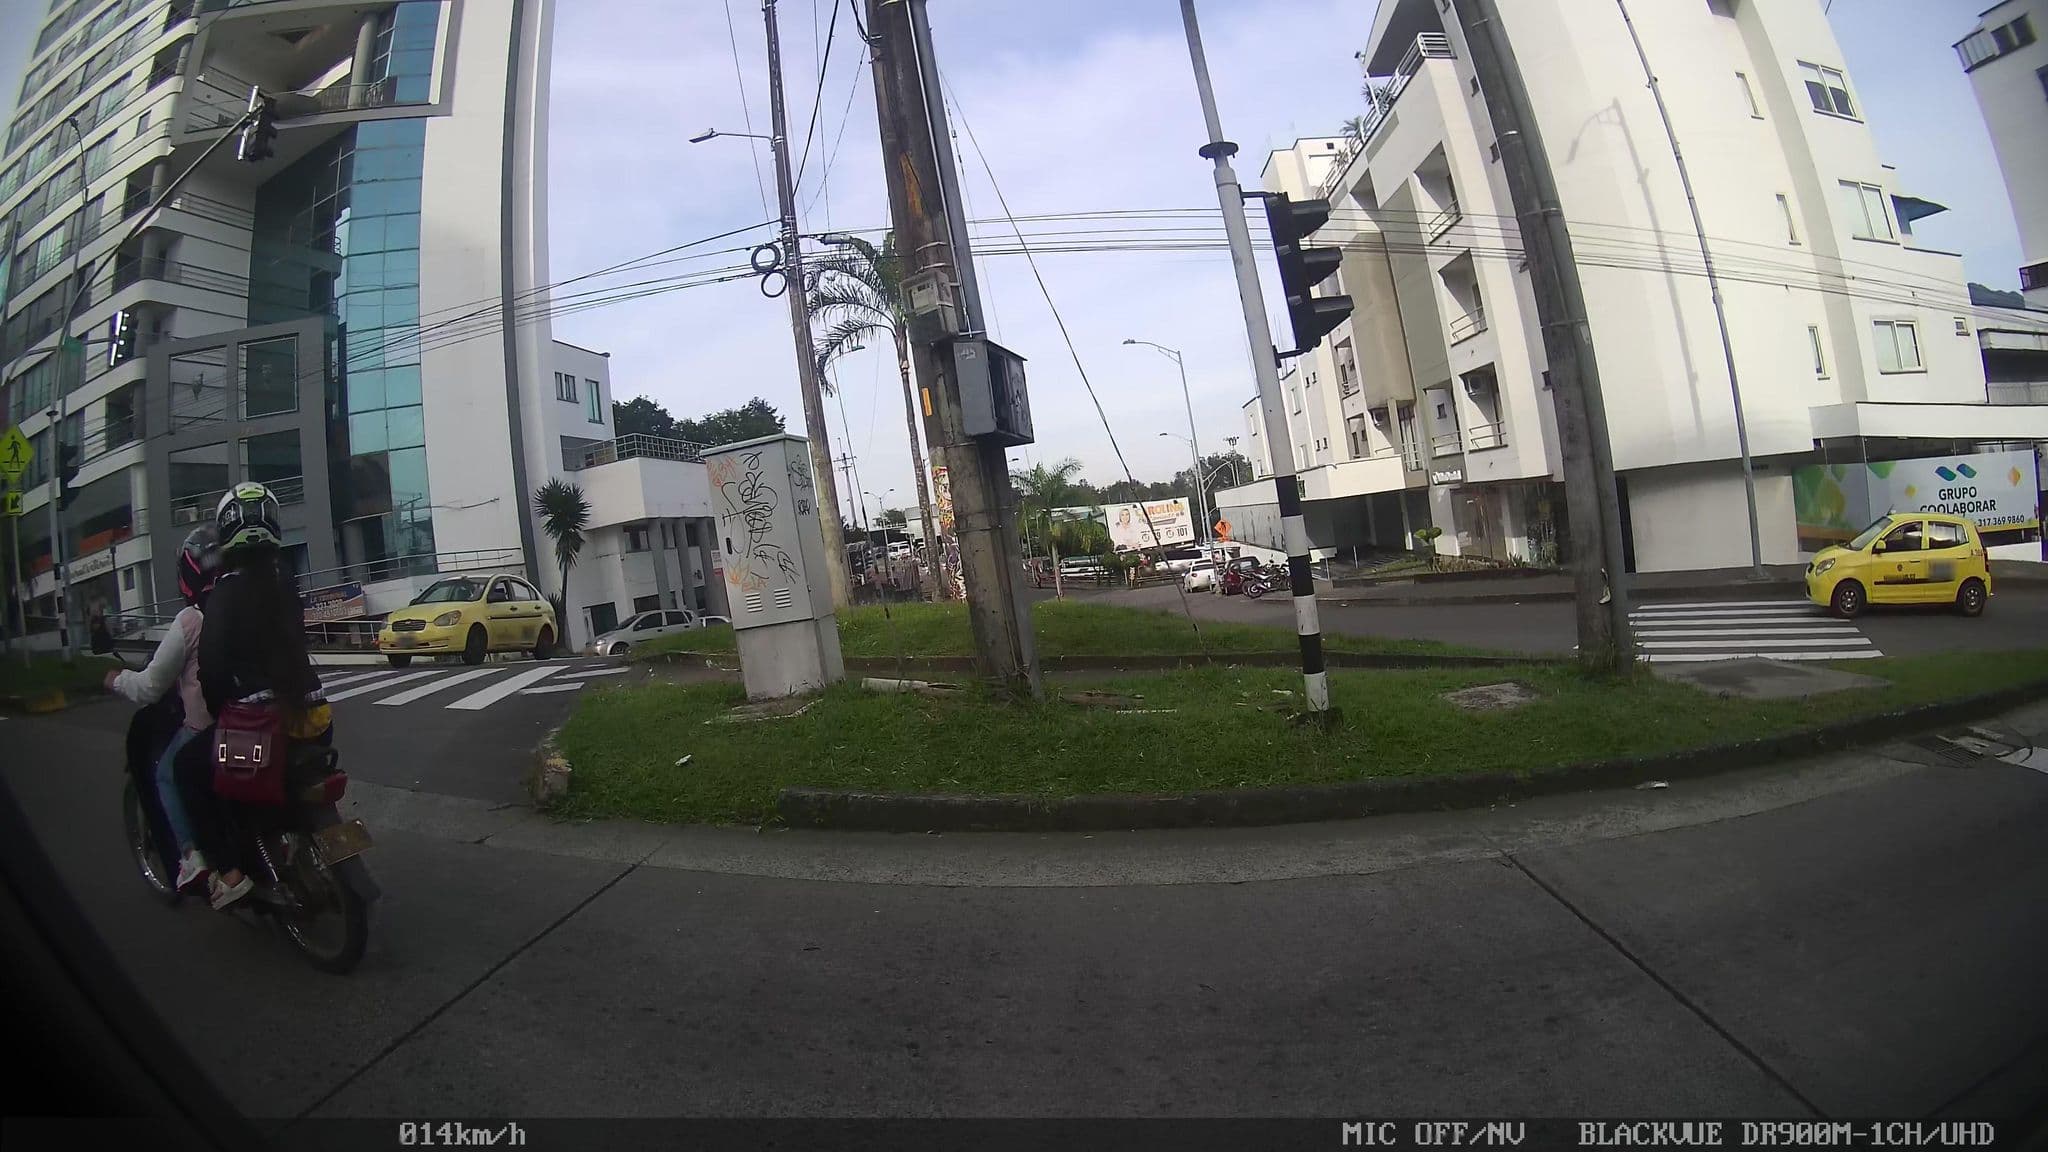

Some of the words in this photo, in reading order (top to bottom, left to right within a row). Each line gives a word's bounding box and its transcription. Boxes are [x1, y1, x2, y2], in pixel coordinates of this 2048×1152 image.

[1938, 486, 1976, 500] GRUPO
[1920, 500, 1996, 514] COOLABORAR
[1978, 518, 1991, 527] 317
[1993, 517, 2006, 526] 369
[2007, 515, 2025, 525] 9860
[1176, 527, 1188, 537] 101
